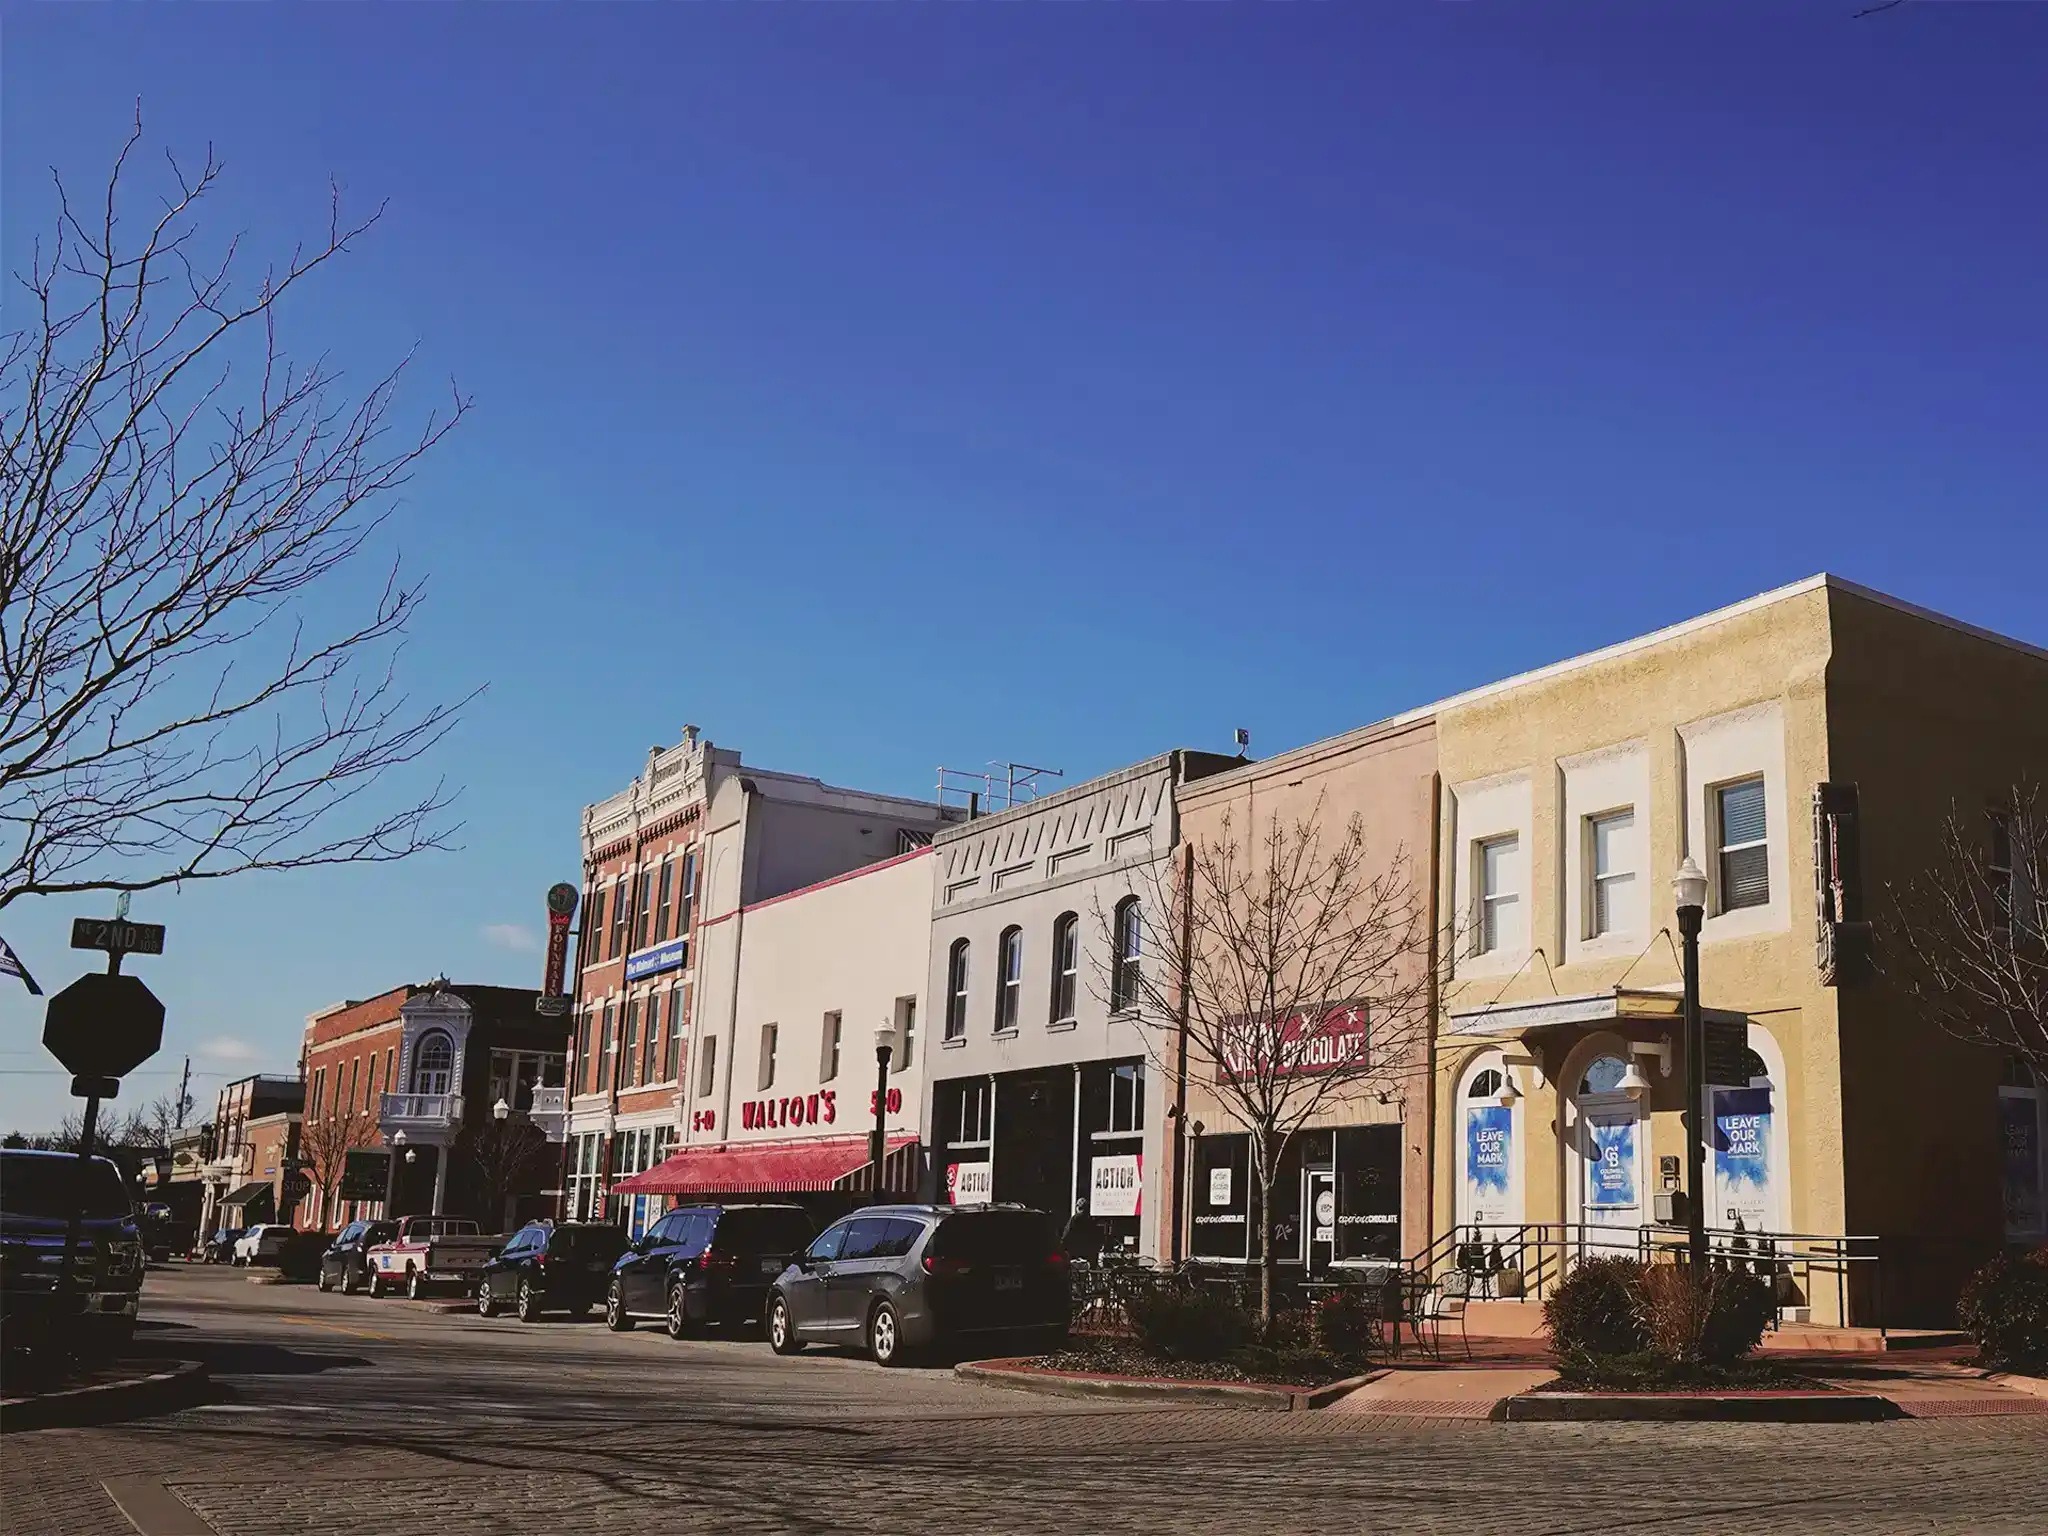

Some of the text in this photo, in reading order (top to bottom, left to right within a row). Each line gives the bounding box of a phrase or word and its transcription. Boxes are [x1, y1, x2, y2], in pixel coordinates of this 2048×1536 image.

[79, 923, 93, 935] NE
[95, 923, 137, 948] 2ND
[548, 925, 565, 997] FOUNTAIN
[1282, 1033, 1364, 1068] CHOCOLATE
[742, 1089, 836, 1131] WALTON'S
[1725, 1116, 1761, 1129] LEAVE
[1476, 1131, 1504, 1142] LEAVE
[1730, 1130, 1756, 1142] OUR
[1479, 1142, 1500, 1153] OUR
[1727, 1142, 1760, 1154] MARK
[1477, 1153, 1503, 1164] MARK
[1095, 1166, 1134, 1190] ACTION
[284, 1180, 310, 1192] STOP
